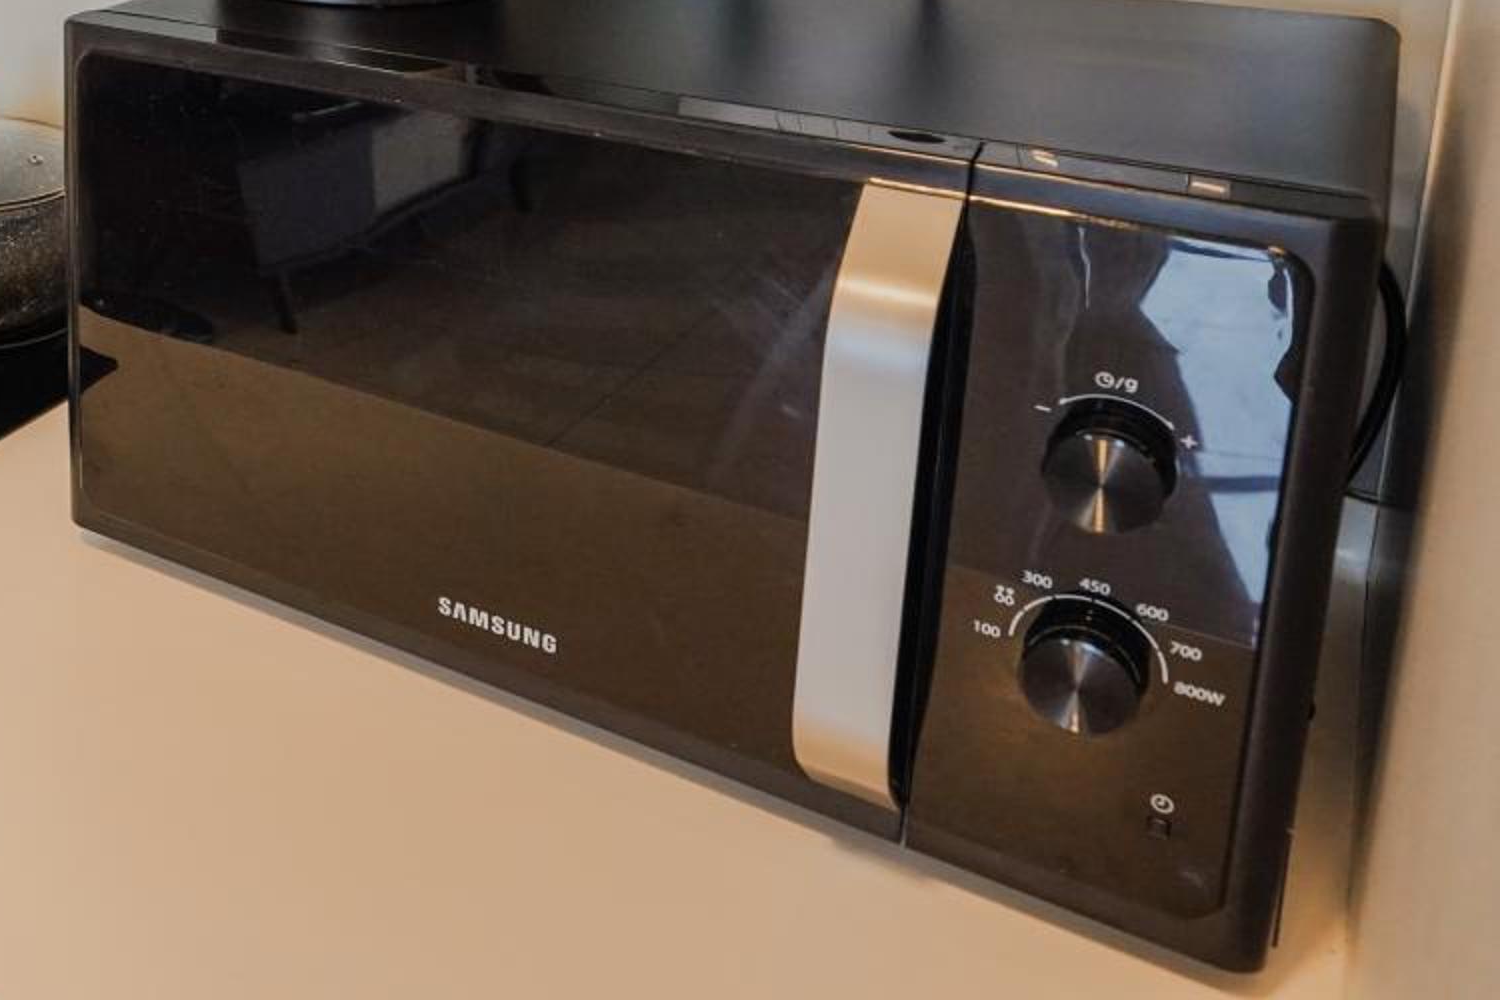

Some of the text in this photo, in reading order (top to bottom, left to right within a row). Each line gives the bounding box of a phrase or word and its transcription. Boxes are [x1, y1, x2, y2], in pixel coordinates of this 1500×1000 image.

[1021, 570, 1053, 589] 300
[1079, 578, 1111, 596] 450
[1135, 603, 1169, 622] 600
[437, 596, 557, 653] SAMSUNG
[973, 620, 1001, 638] 100
[1169, 640, 1202, 661] 700
[1173, 681, 1226, 706] 800W
